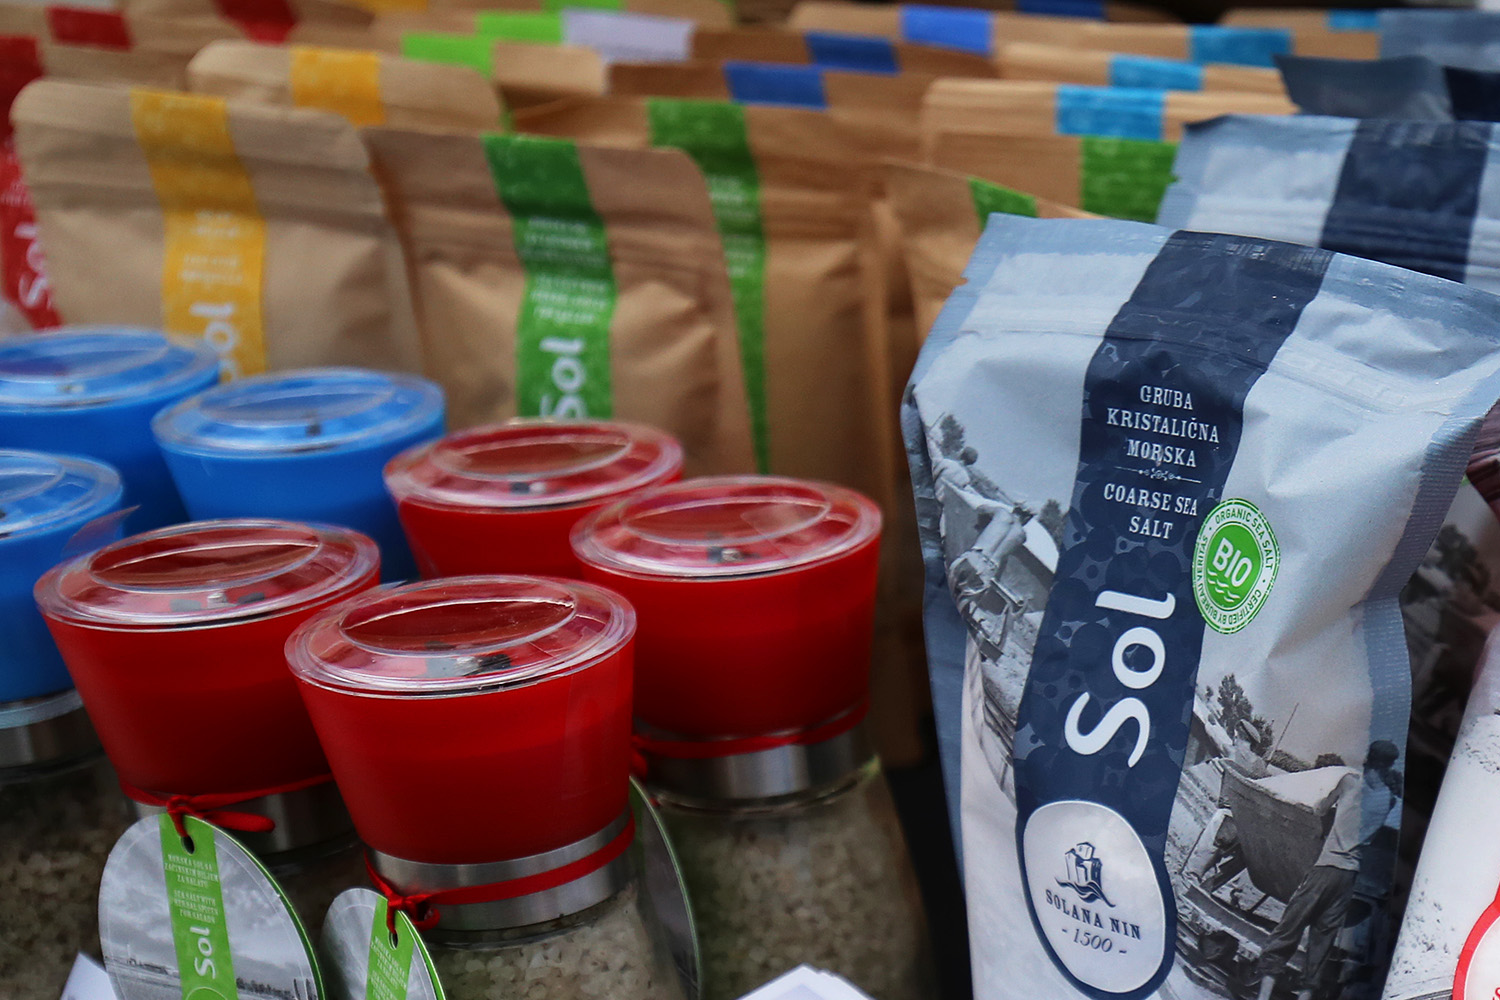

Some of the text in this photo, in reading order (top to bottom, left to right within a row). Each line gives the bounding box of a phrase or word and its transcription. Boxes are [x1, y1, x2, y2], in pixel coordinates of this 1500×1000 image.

[1140, 385, 1193, 410] GRUBA
[1107, 407, 1219, 443] KRISTALIČNA
[1126, 439, 1197, 468] MORSKA
[1103, 483, 1198, 517] COARSE SEA
[1129, 516, 1173, 539] SALT
[1215, 508, 1274, 570] ORGANIC SEA SALT
[1196, 535, 1208, 582] VERITAS
[1212, 537, 1253, 588] BIO
[1197, 583, 1219, 620] BUREAU
[1228, 589, 1262, 625] CERTIFIED
[1064, 590, 1176, 768] Sol
[1046, 889, 1141, 940] SOLANA NIN
[190, 926, 216, 980] Sol
